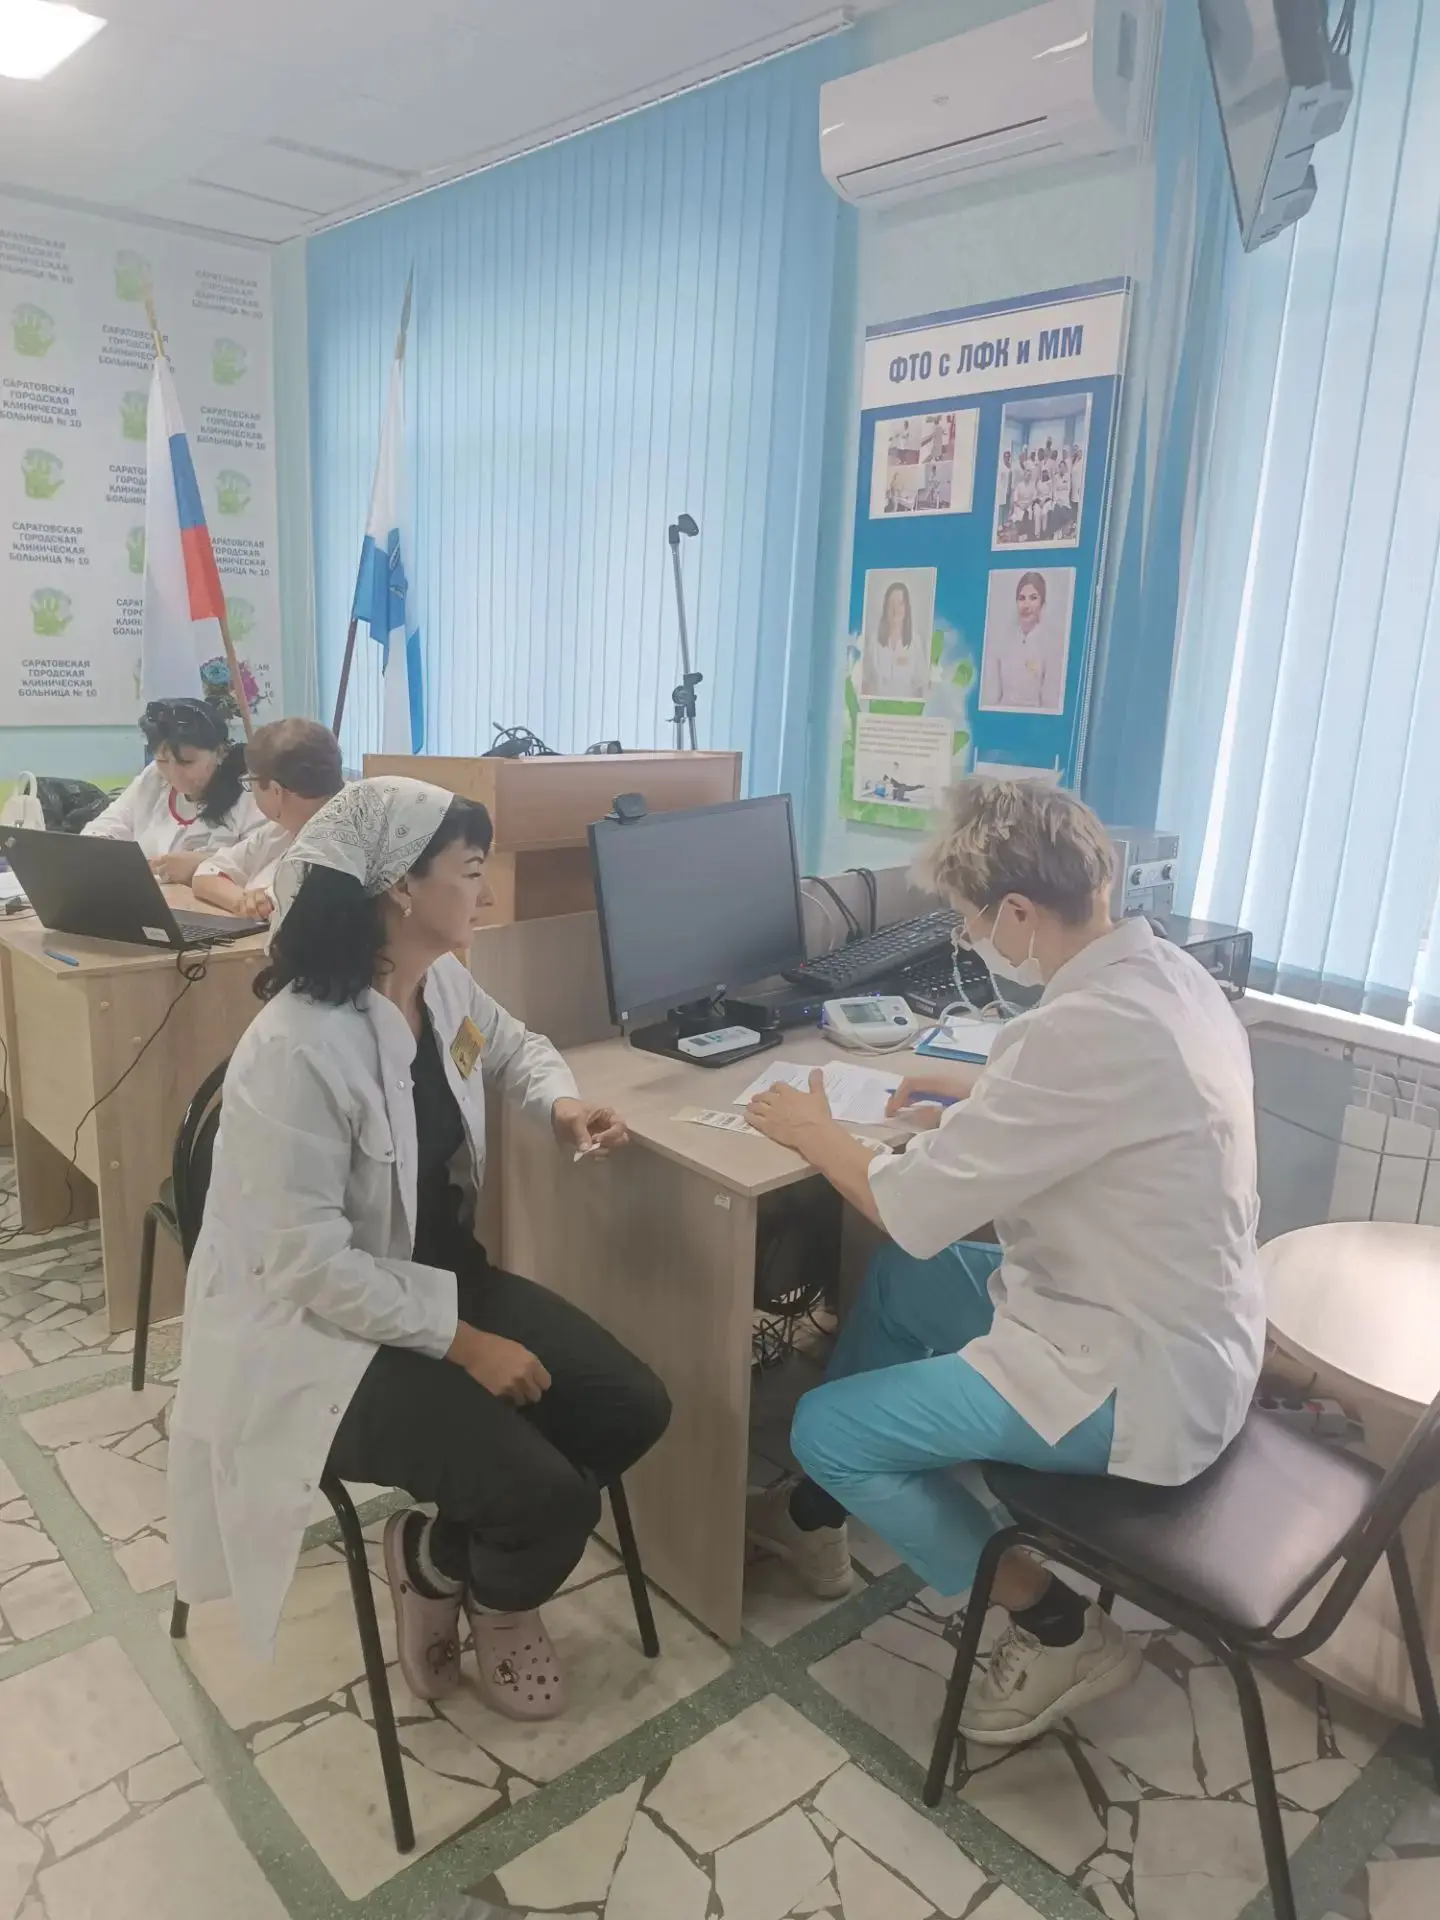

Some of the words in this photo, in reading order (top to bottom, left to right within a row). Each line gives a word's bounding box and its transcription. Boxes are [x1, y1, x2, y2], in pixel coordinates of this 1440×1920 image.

[889, 351, 932, 384] ФТО
[938, 353, 951, 377] с
[956, 337, 1010, 374] ЛФК
[1016, 339, 1030, 365] и
[1038, 325, 1084, 362] ММ
[3, 378, 75, 396] САРАТОВСКАЯ
[10, 390, 69, 405] ГОРОДСКАЯ
[3, 400, 77, 417] КЛИНИЧЕСКАЯ
[0, 410, 53, 425] БОЛЬНИЦА
[69, 419, 82, 428] 10
[256, 442, 266, 450] 10
[12, 522, 83, 535] САРАТОВСКАЯ
[20, 533, 77, 545] ГОРОДСКАЯ
[212, 537, 265, 549] АРАТОВСКАЯ
[12, 543, 85, 555] КЛИНИЧЕСКАЯ
[215, 547, 260, 557] ОРОДСКАЯ
[9, 552, 62, 565] БОЛЬНИЦА
[78, 558, 90, 566] 10
[216, 557, 266, 567] ИНИЧЕСКАЯ
[260, 568, 270, 577] 10
[21, 659, 91, 668] САРАТОВСКАЯ
[28, 669, 85, 678] ГОРОДСКАЯ
[21, 679, 93, 688] КЛИНИЧЕСКАЯ
[18, 689, 70, 698] БОЛЬНИЦА
[86, 689, 98, 698] 10
